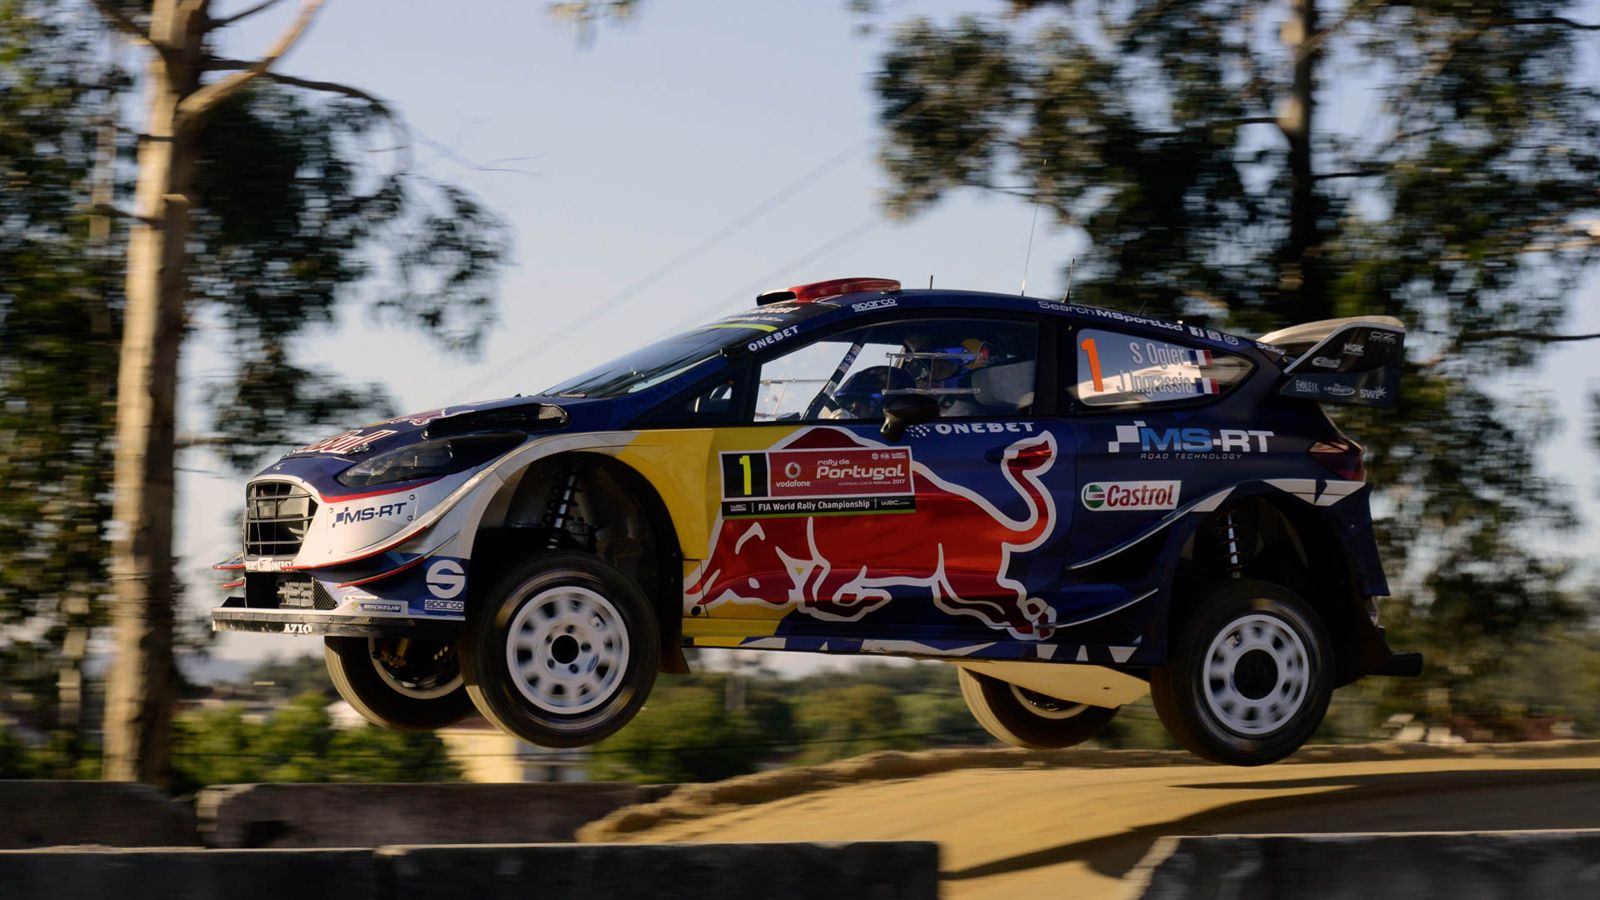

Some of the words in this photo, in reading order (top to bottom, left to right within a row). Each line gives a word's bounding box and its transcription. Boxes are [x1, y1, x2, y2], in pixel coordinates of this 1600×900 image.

[851, 298, 898, 311] sparco
[747, 325, 798, 352] ONEBET
[1080, 338, 1104, 392] 1
[1129, 342, 1143, 364] S
[1146, 342, 1185, 369] Ogier
[1116, 370, 1126, 392] J
[1128, 370, 1193, 397] Ingrassia
[935, 422, 1034, 434] ONEBET
[1140, 427, 1275, 453] MS-RT
[738, 455, 752, 495] 1
[776, 480, 811, 488] vodafone
[816, 464, 905, 481] Portugal
[758, 503, 771, 511] FIA
[773, 502, 795, 511] World
[797, 502, 816, 511] Rally
[818, 500, 870, 510] Championship
[1107, 484, 1174, 507] Castrol
[426, 601, 464, 610] sparco
